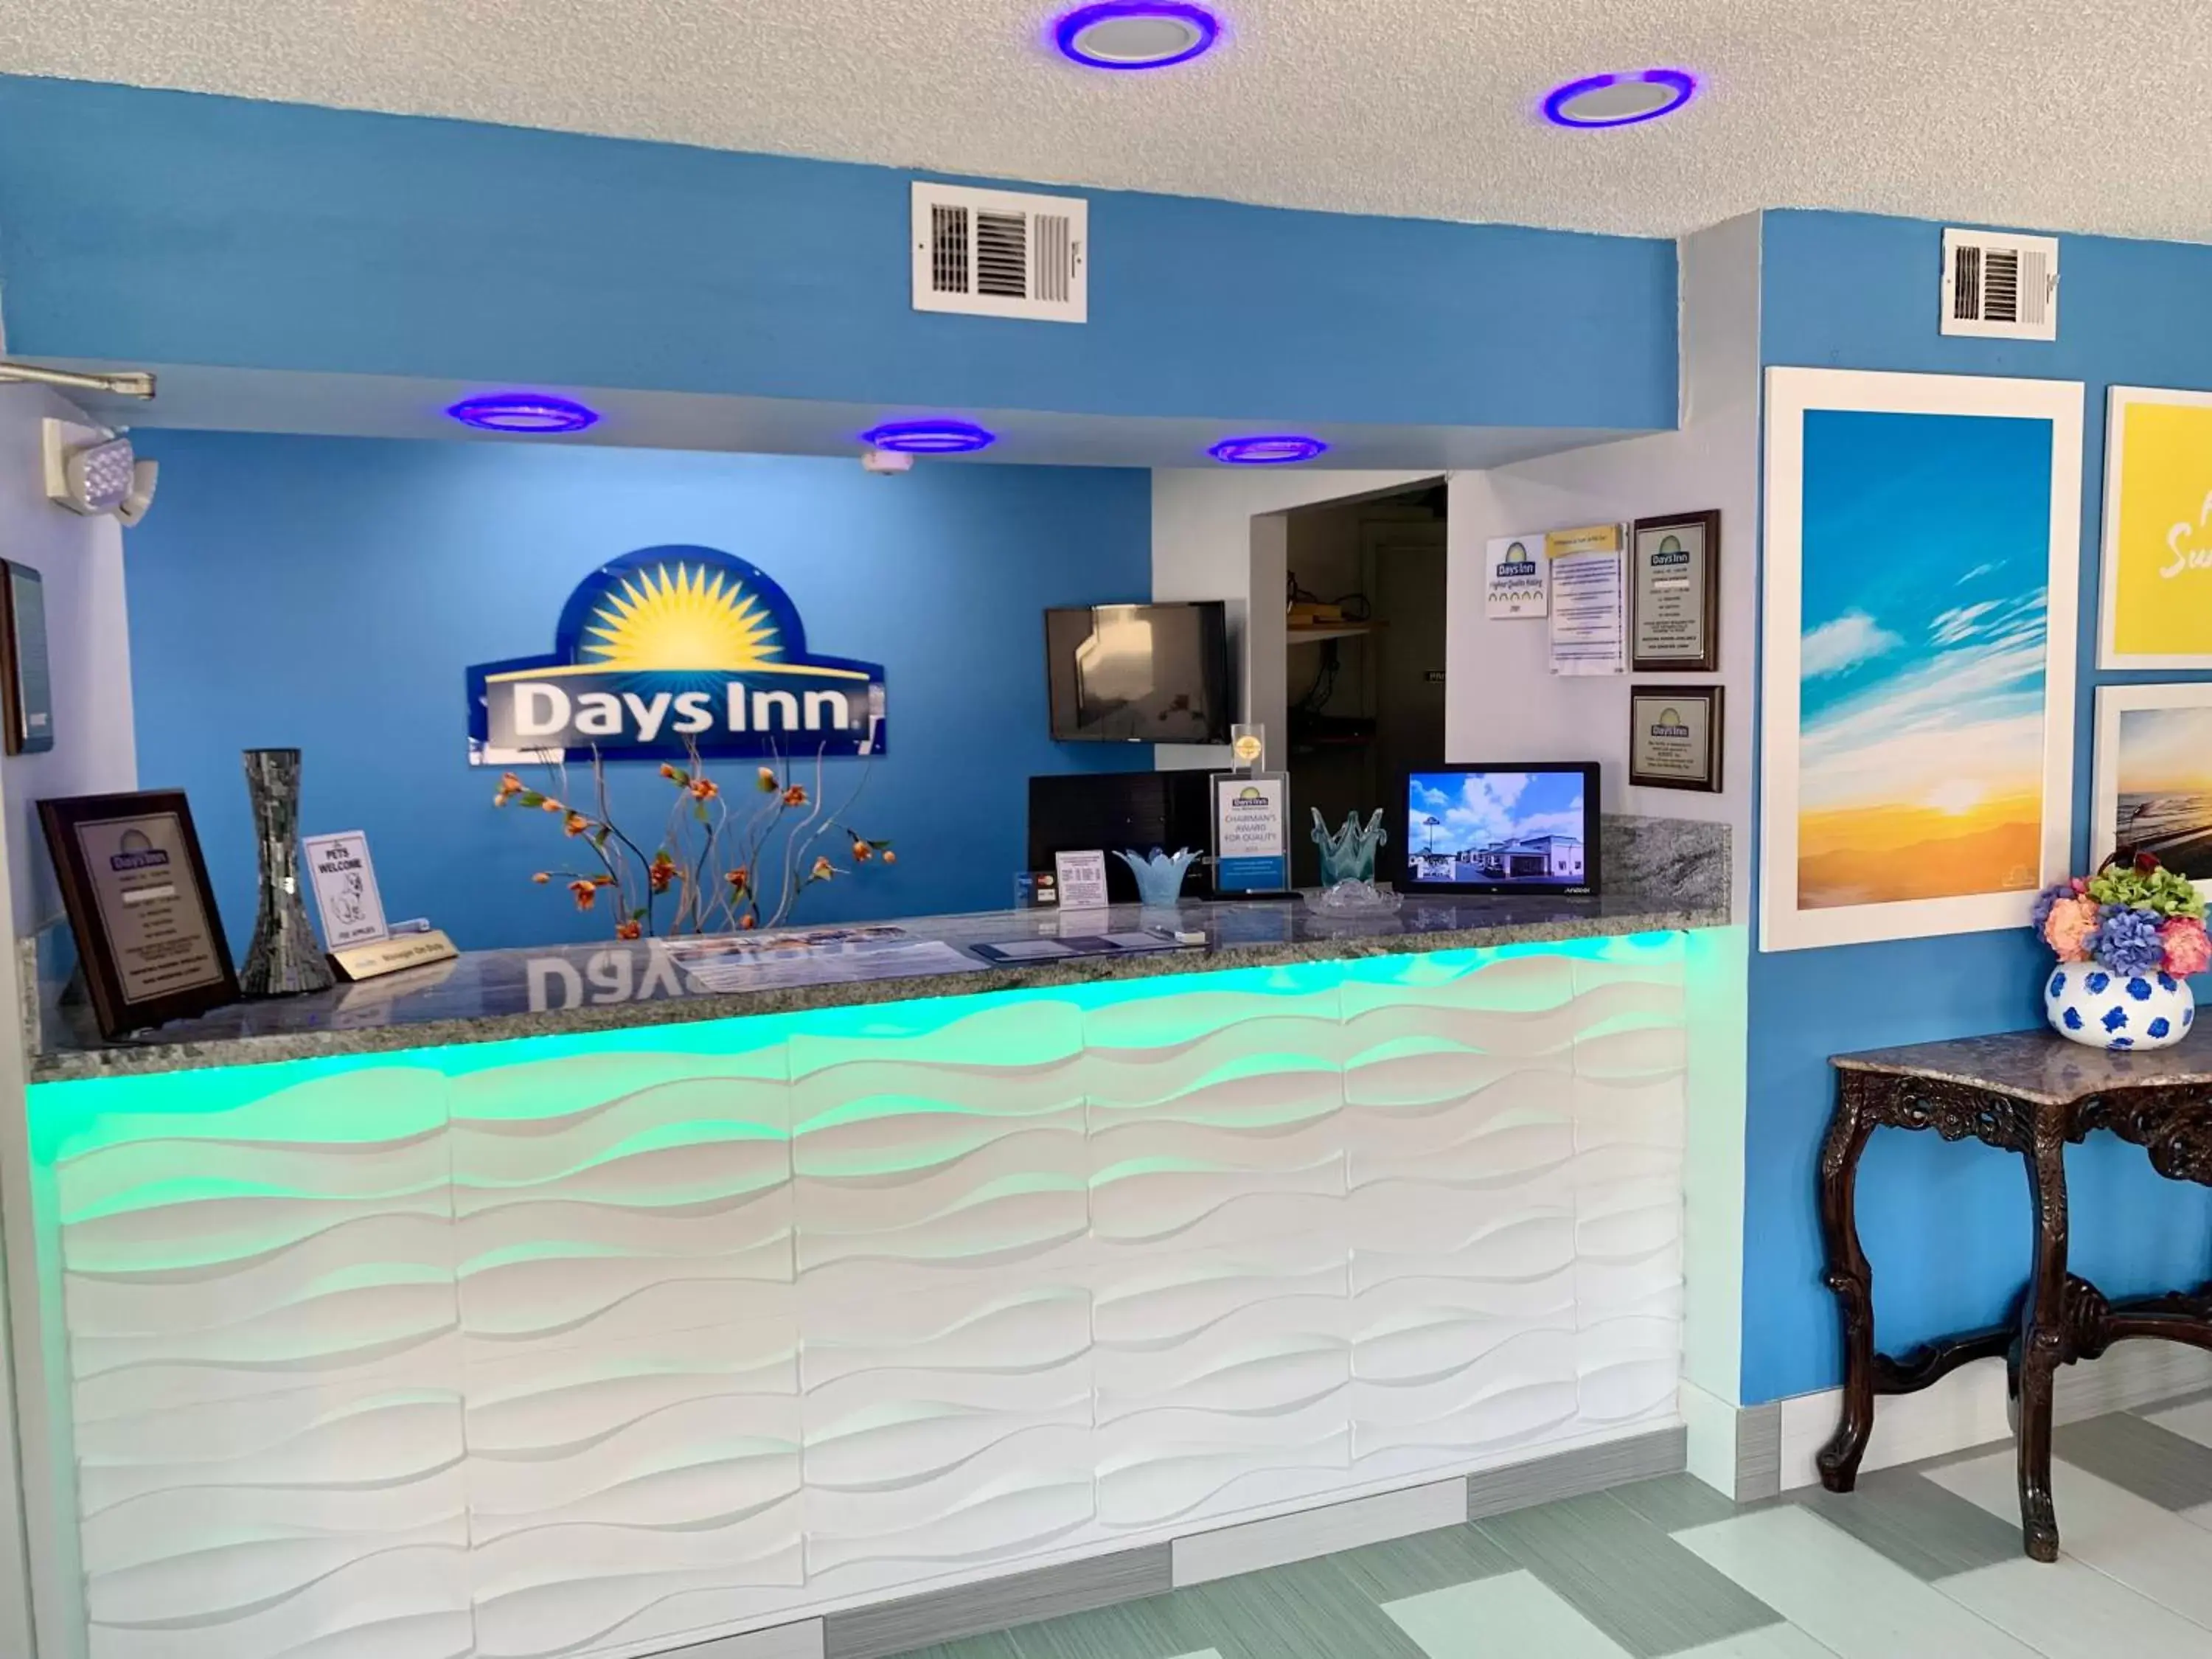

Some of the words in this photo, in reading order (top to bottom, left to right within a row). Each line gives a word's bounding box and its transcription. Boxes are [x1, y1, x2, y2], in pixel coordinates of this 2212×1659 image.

[1652, 554, 1673, 565] Days
[1674, 553, 1688, 562] Inn
[1498, 565, 1519, 576] Days
[514, 682, 714, 742] Days
[727, 681, 849, 731] Inn
[1225, 814, 1277, 823] CHAIRMAN'S
[1235, 824, 1266, 832] AWARD
[1224, 834, 1241, 842] FOR
[1242, 832, 1277, 841] QUALITY
[325, 847, 349, 860] PETS
[319, 858, 363, 873] WELCOME
